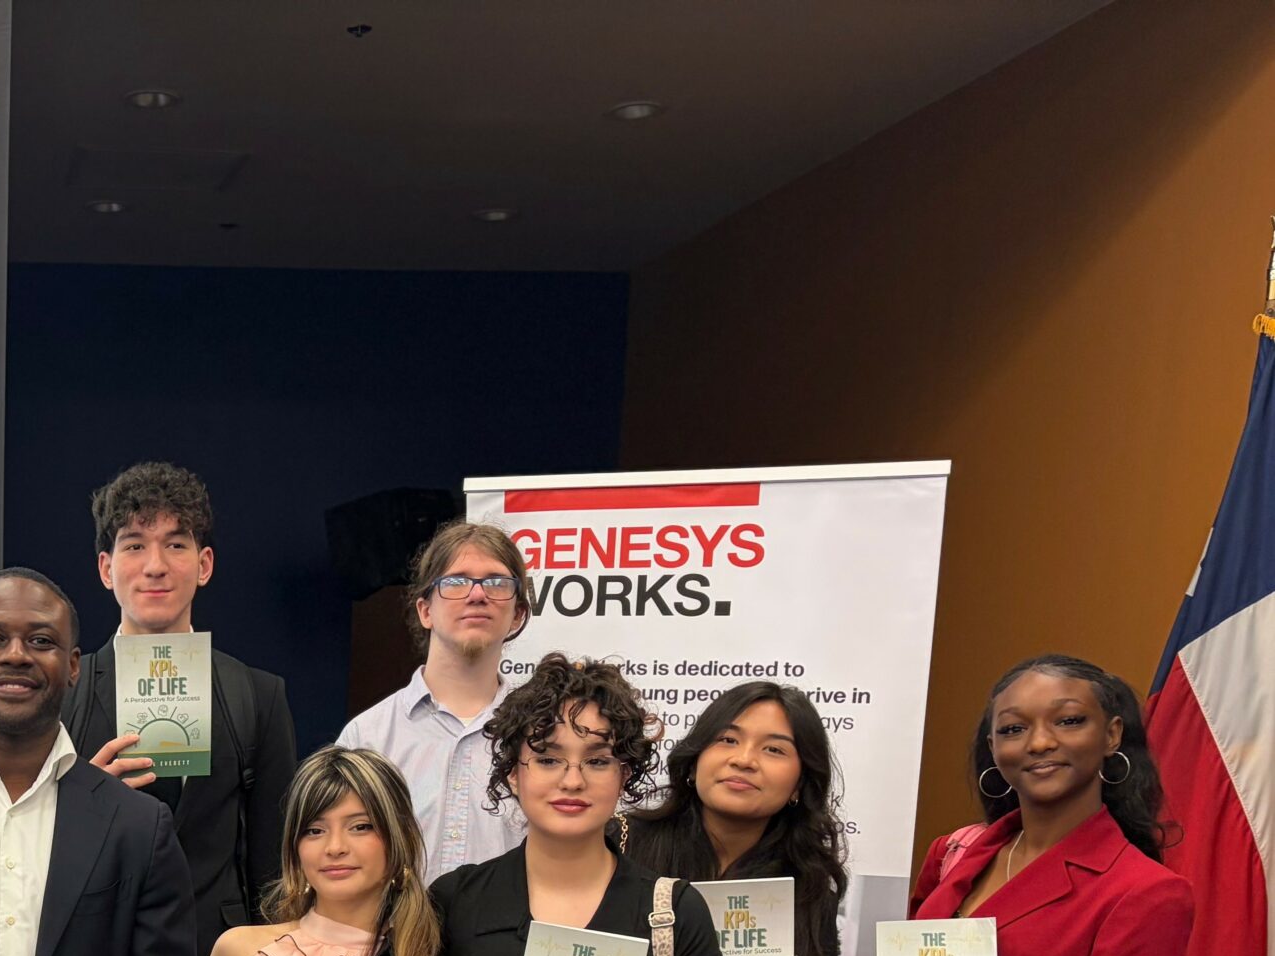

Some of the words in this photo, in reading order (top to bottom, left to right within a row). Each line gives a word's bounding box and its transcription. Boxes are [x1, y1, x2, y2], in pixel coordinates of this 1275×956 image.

[152, 646, 172, 659] THE
[653, 660, 669, 676] is
[674, 660, 778, 677] dedicated
[784, 661, 805, 677] to
[138, 678, 155, 696] OF
[159, 677, 187, 695] LIFE
[852, 688, 871, 704] in
[662, 711, 680, 726] to
[727, 895, 749, 909] THE
[734, 928, 767, 948] LIFE
[921, 932, 946, 947] THE
